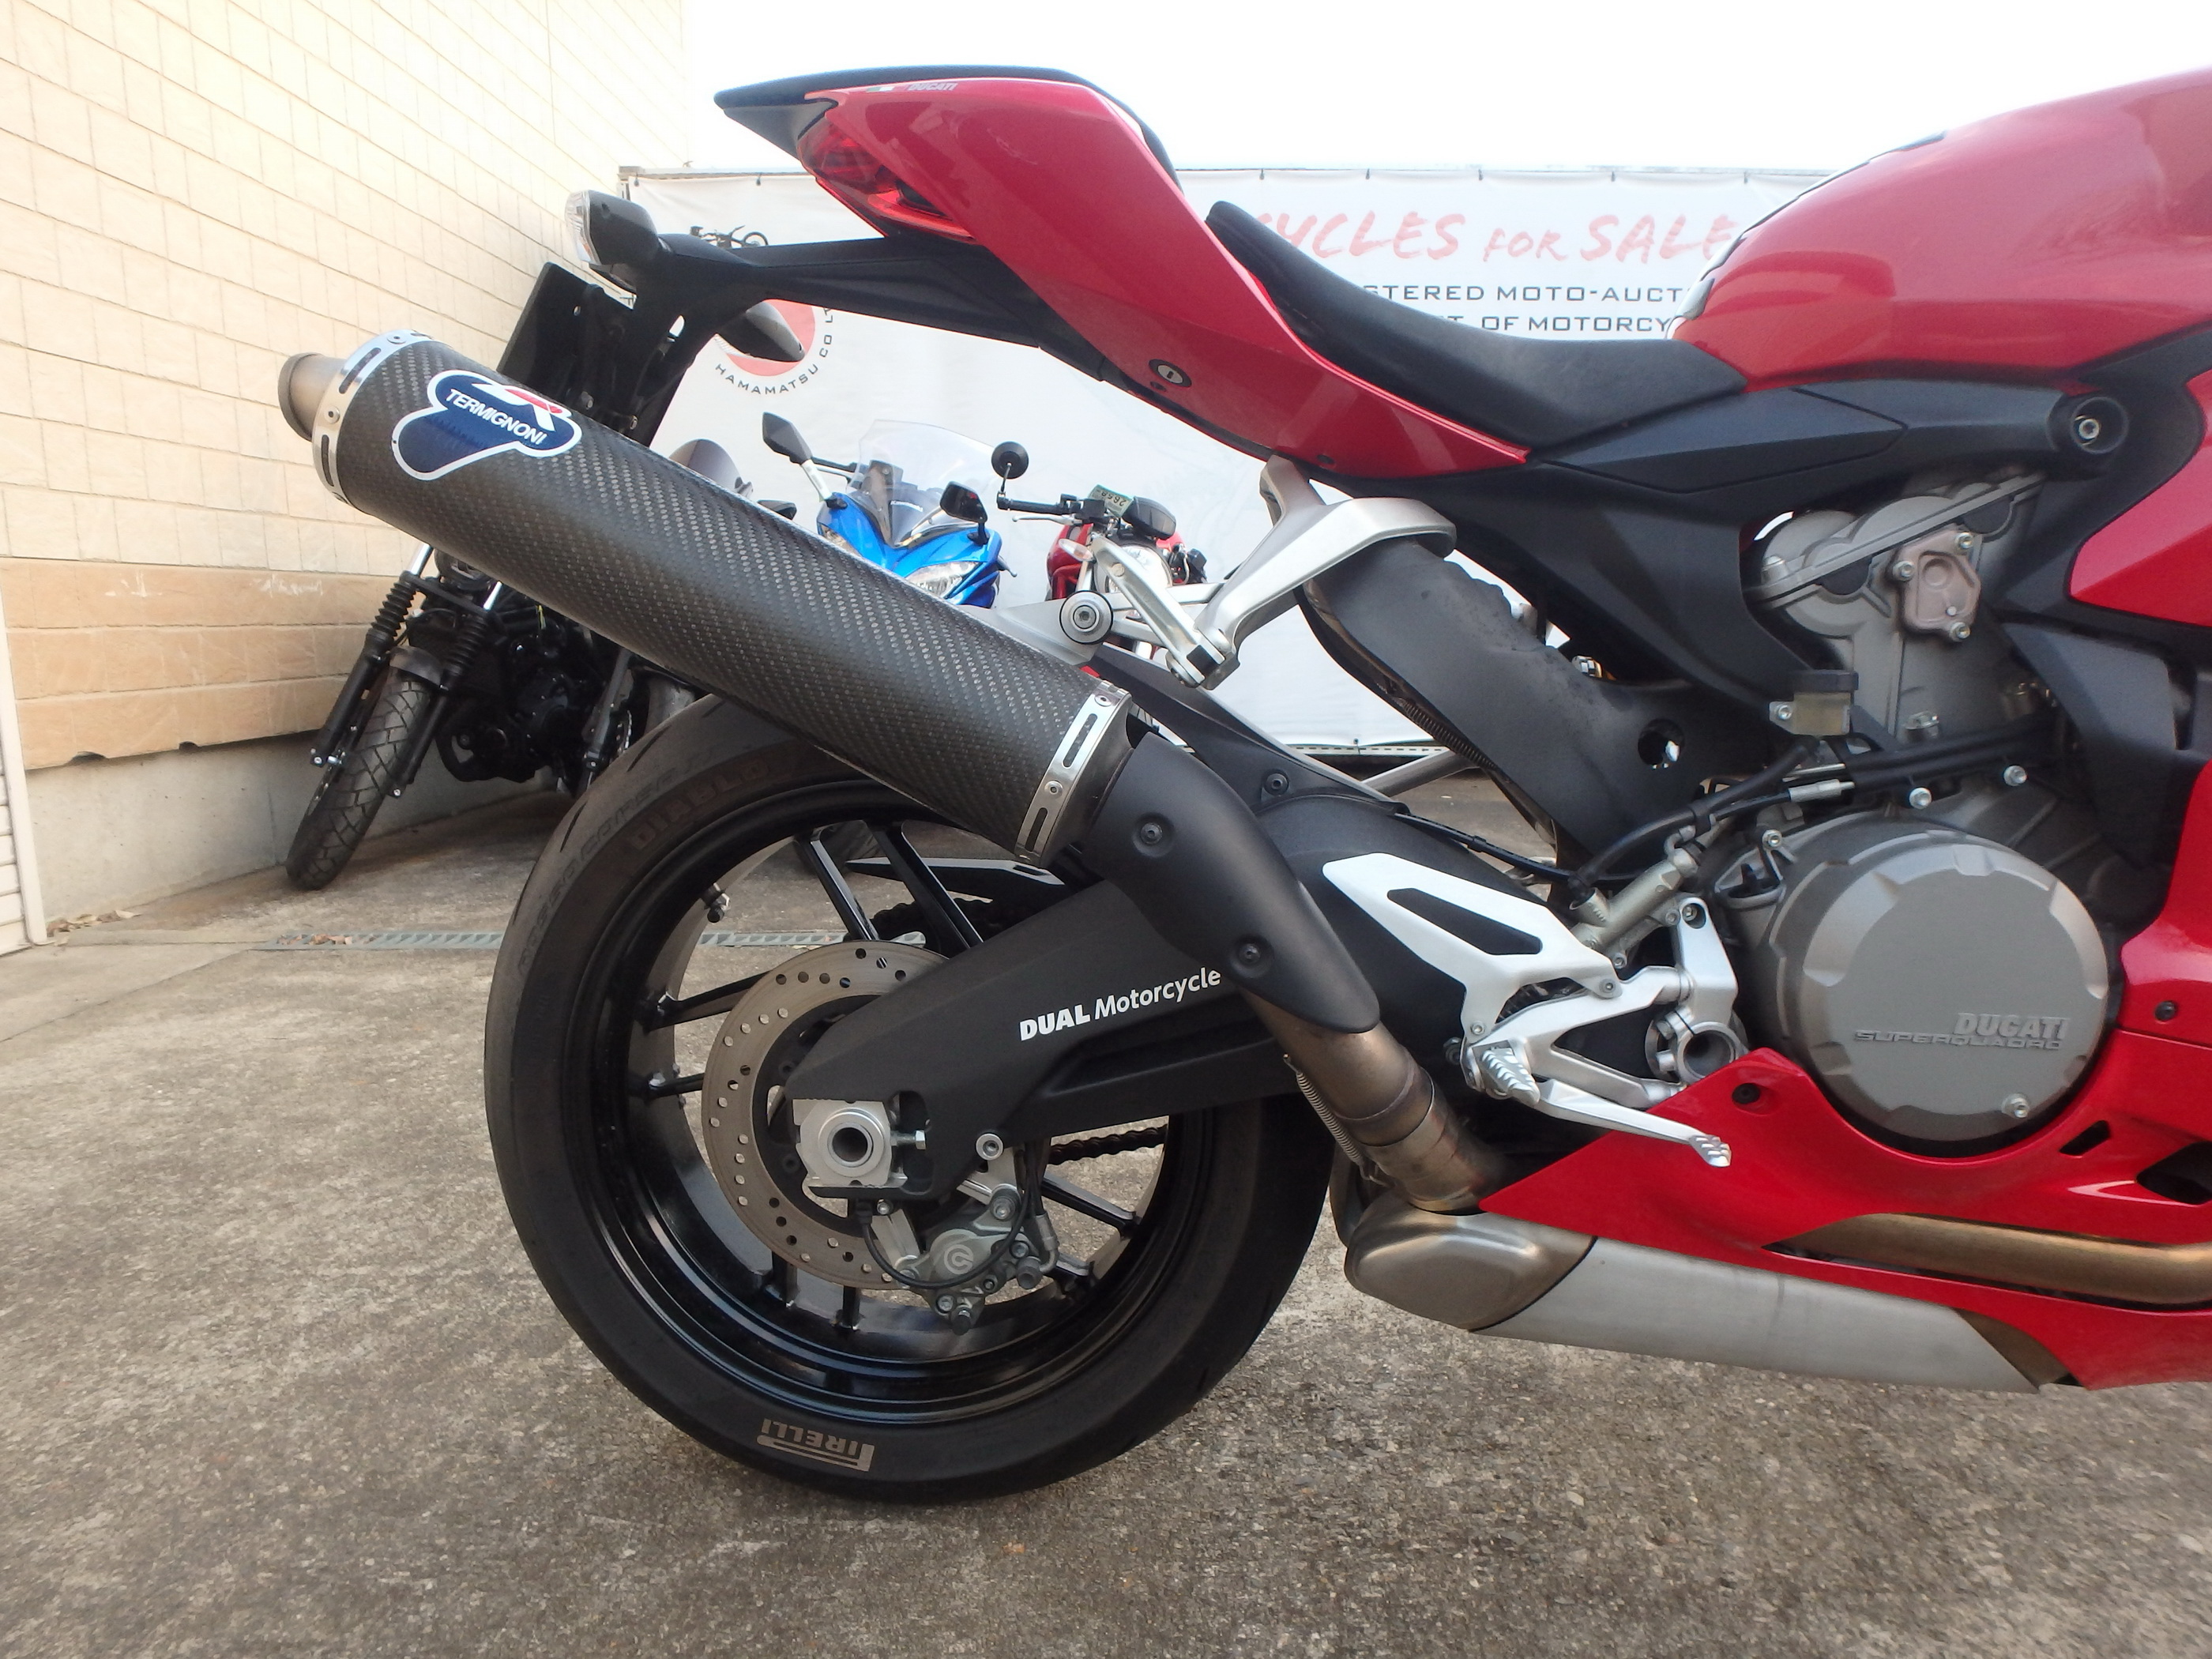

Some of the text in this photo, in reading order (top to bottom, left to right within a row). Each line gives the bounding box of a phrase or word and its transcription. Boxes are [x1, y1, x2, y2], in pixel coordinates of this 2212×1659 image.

[908, 82, 958, 91] DUCATI
[1257, 210, 1465, 261] YCLES
[1580, 213, 1737, 264] SALE
[1498, 286, 1691, 302] MOTO-AUCT
[1480, 316, 1518, 330] OF
[1529, 317, 1672, 331] MOTORCY
[715, 363, 818, 395] HAMAMATSU
[818, 334, 833, 358] CO
[446, 388, 547, 445] TERMIGNONI
[1020, 967, 1221, 1041] DUAL Motorcycle
[1952, 1012, 2071, 1040] DUCATI
[756, 1418, 875, 1472] PIRELLI
